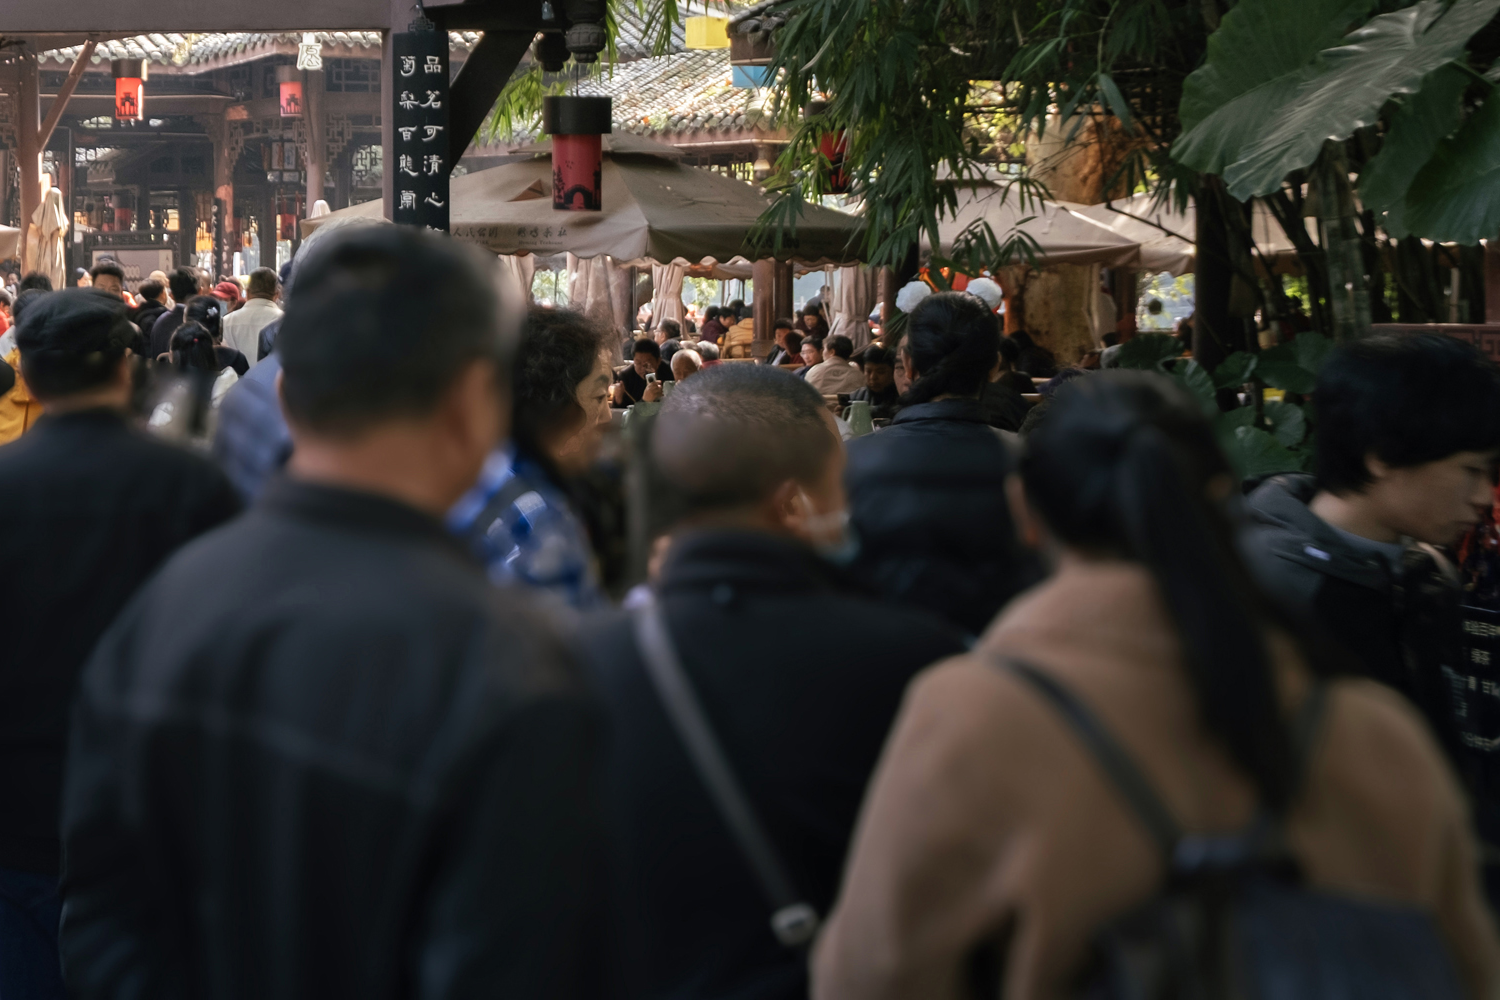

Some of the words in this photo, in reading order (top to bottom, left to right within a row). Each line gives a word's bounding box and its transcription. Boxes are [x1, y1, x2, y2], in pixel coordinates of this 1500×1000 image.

[420, 56, 444, 232] 品茗可清心
